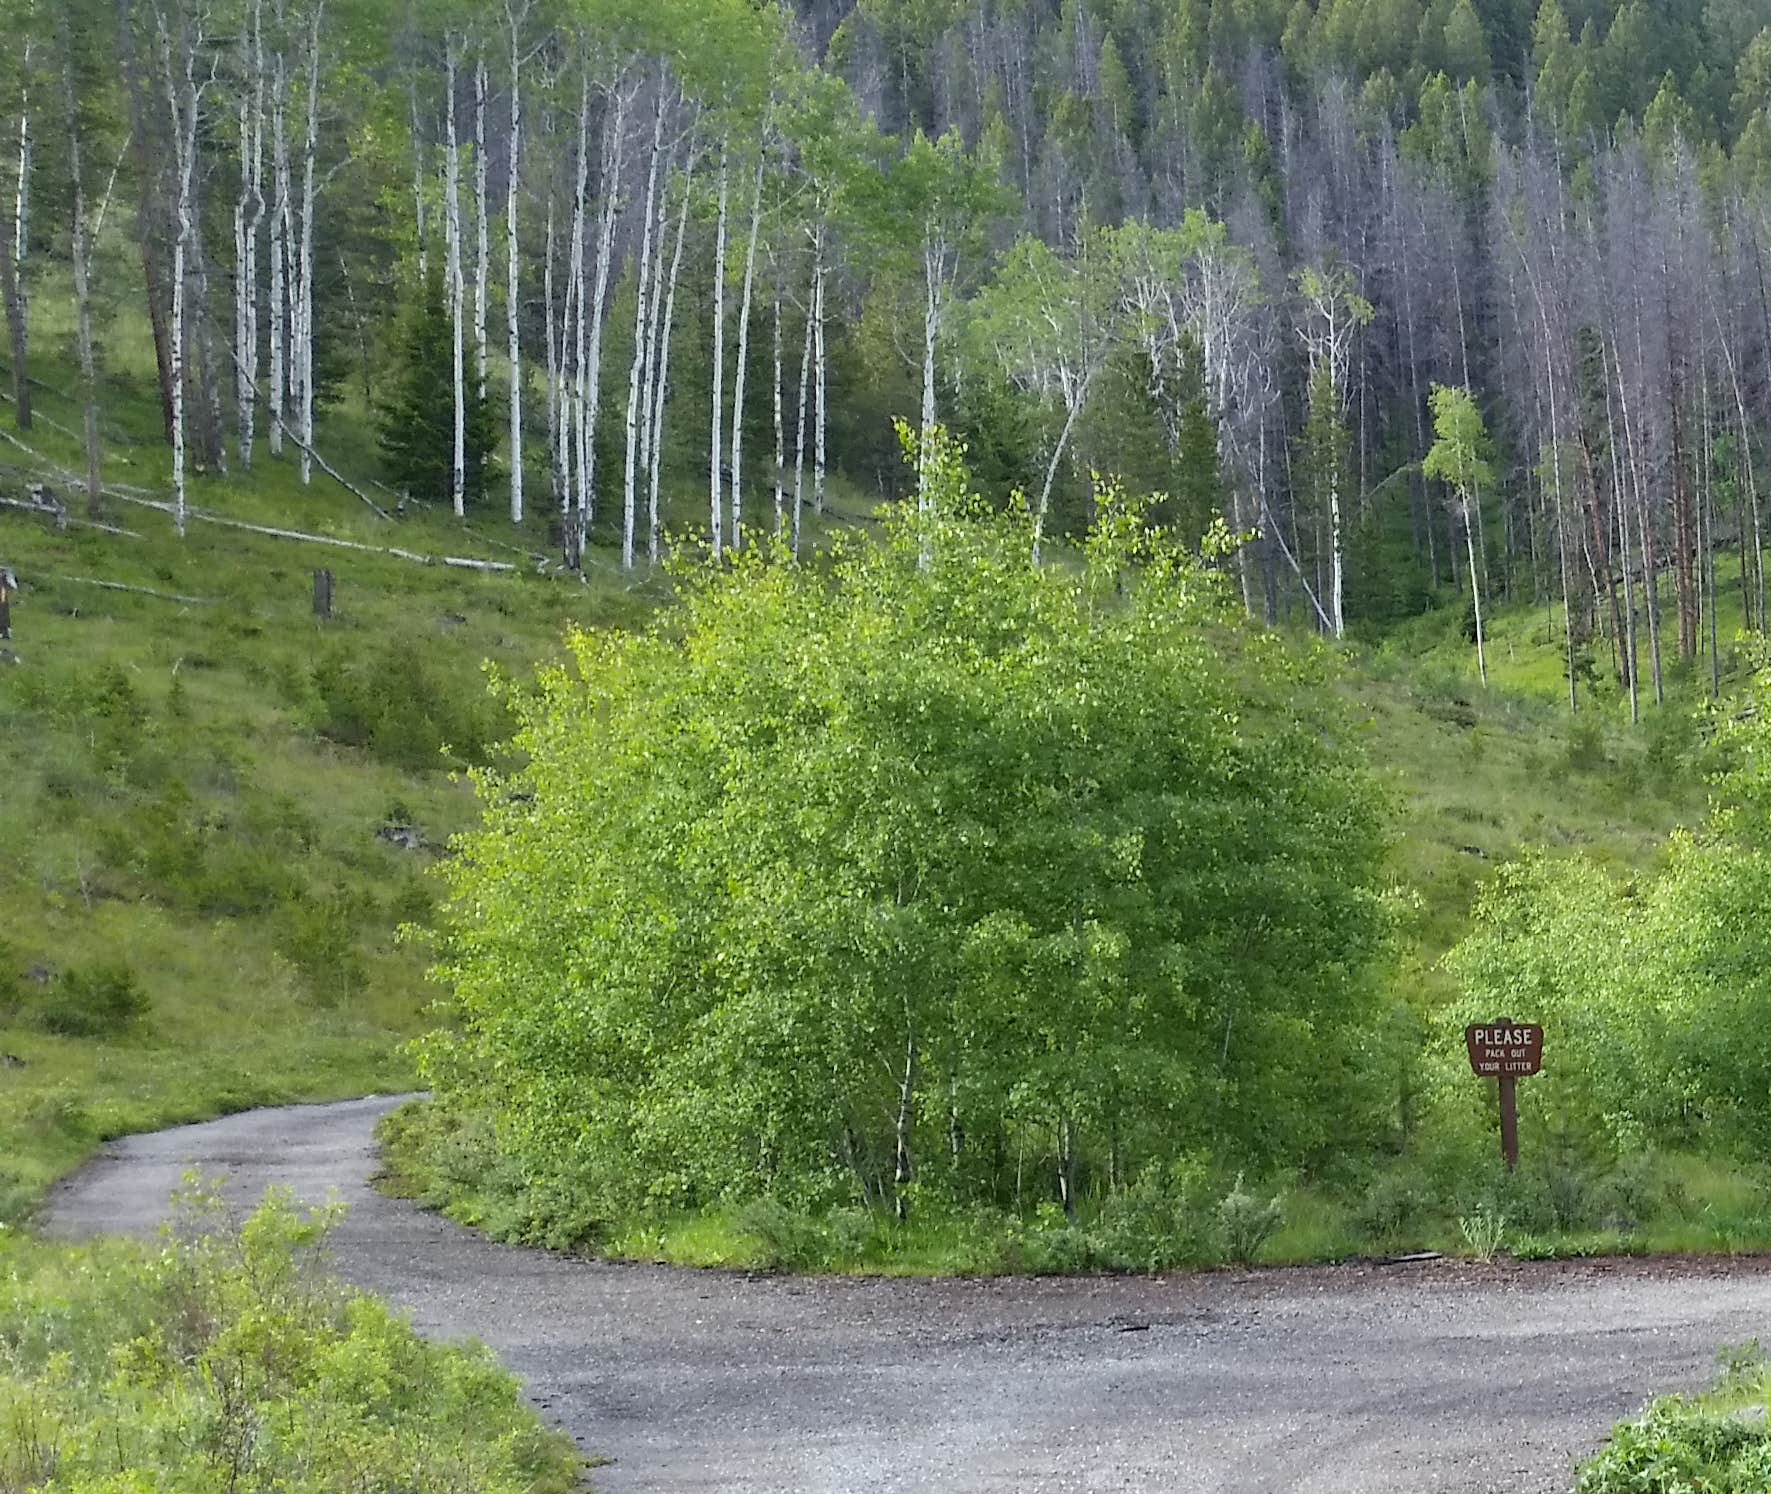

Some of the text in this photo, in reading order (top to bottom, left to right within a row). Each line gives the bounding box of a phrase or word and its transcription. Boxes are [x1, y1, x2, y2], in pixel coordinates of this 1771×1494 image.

[1475, 1029, 1532, 1045] PLEASE
[1485, 1049, 1526, 1058] PACK OUT
[1479, 1062, 1532, 1071] YOUR LITTER
